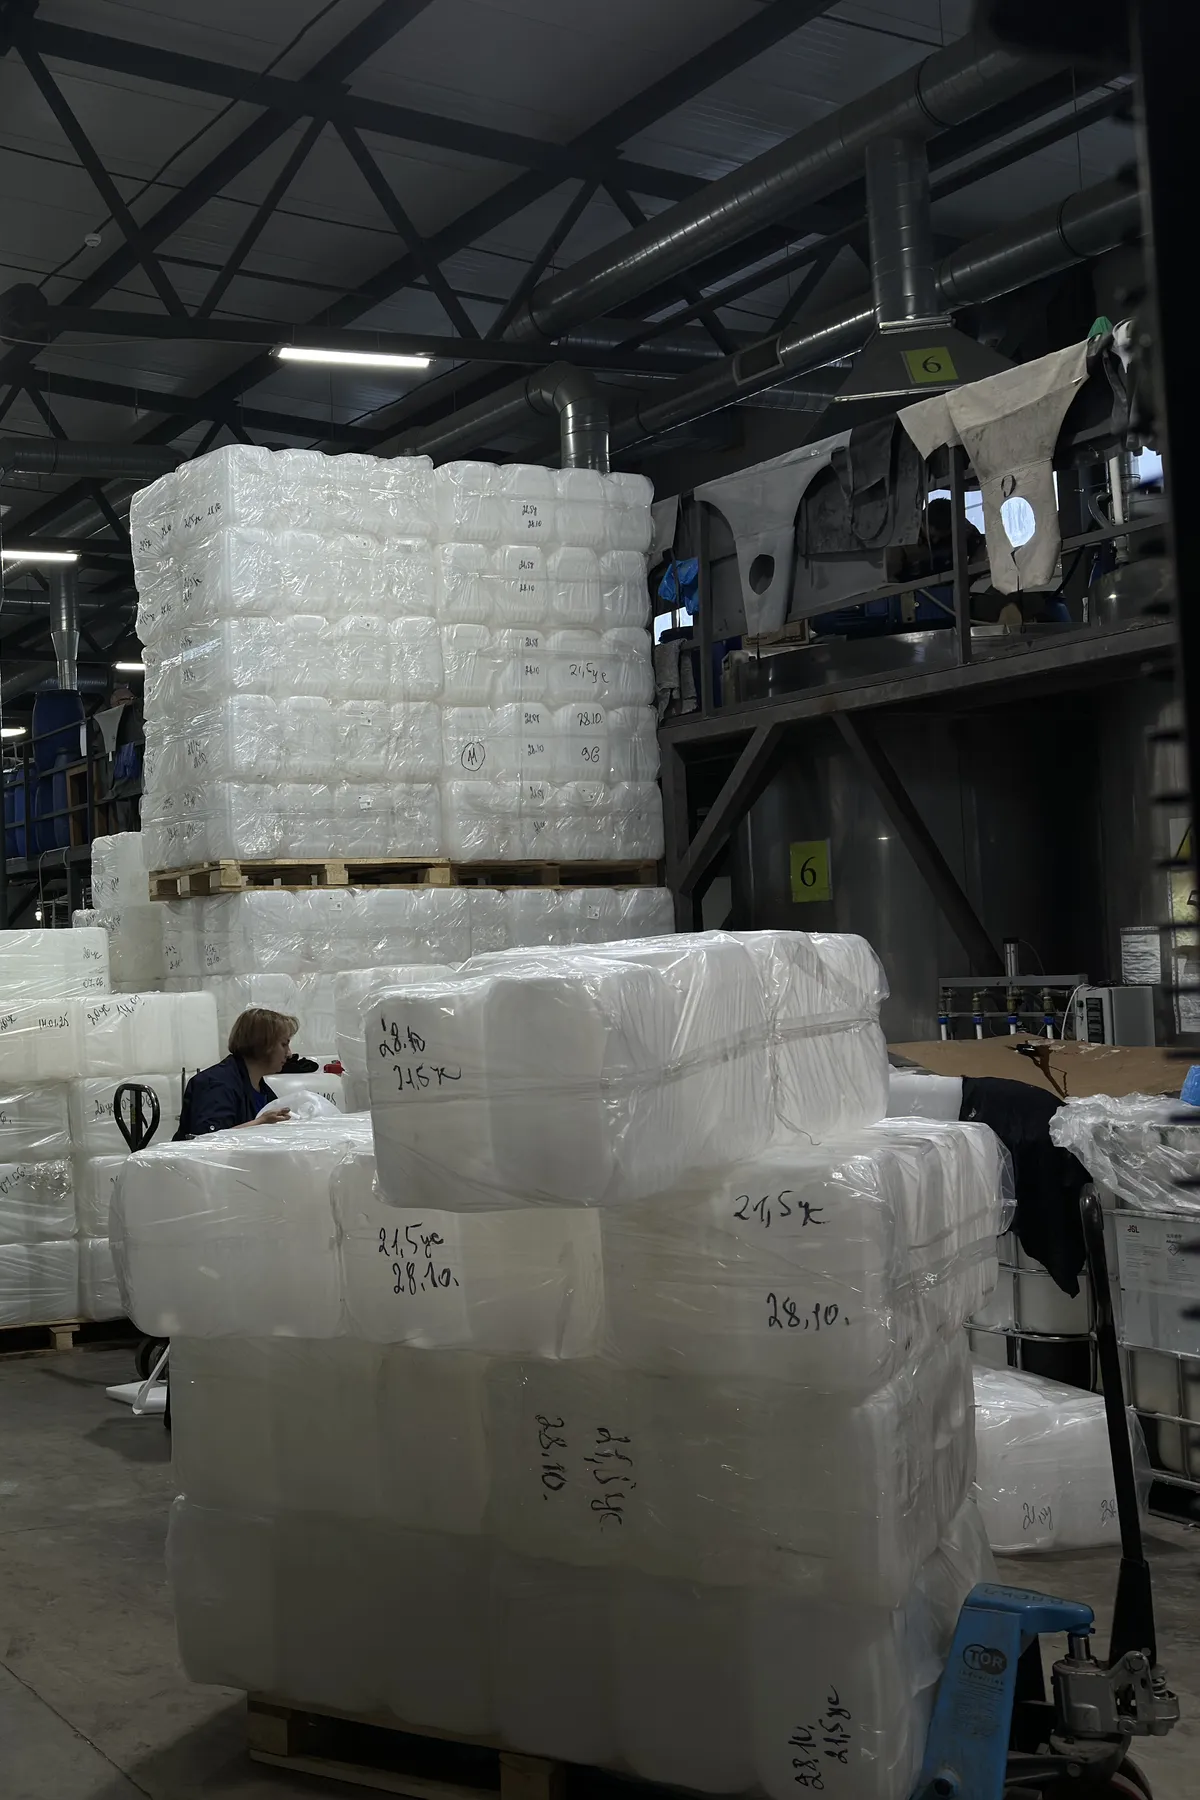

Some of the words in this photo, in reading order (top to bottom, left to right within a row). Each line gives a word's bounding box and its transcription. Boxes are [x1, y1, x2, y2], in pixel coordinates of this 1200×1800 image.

[922, 355, 941, 373] 6
[581, 746, 600, 763] 96
[800, 856, 817, 887] 6
